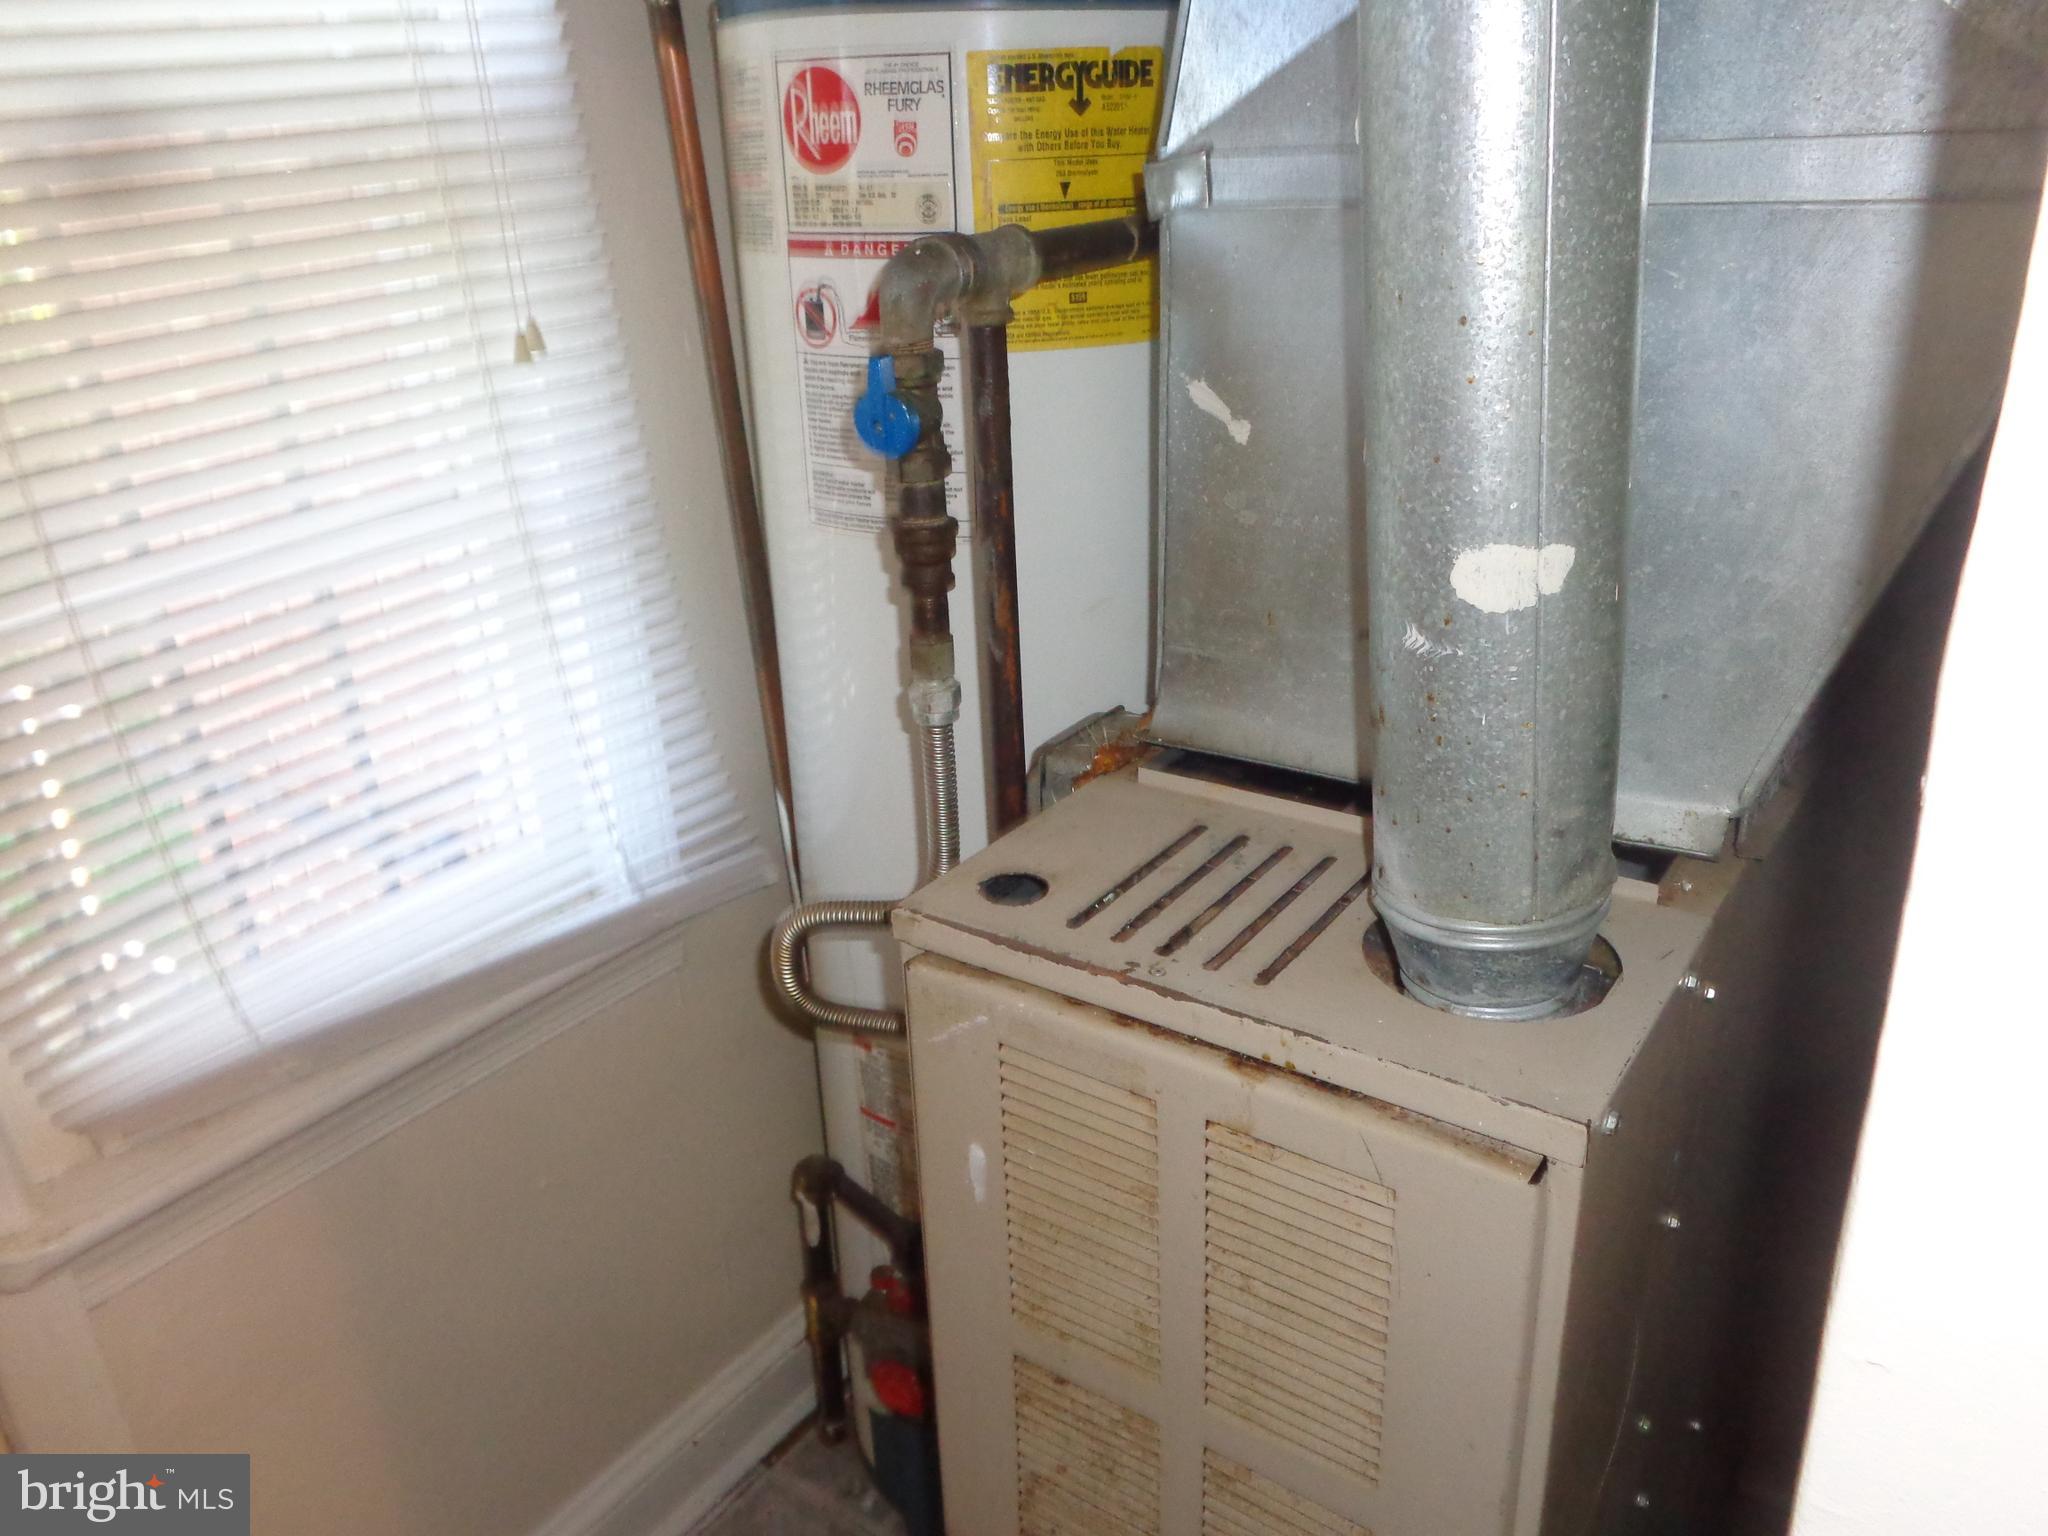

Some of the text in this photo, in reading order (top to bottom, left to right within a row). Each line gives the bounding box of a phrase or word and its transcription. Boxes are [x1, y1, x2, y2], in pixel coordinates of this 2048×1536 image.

[864, 79, 945, 97] RHEEMGLAS
[887, 98, 922, 112] FURY
[789, 66, 858, 161] Rheem
[1020, 130, 1034, 140] the
[1035, 128, 1062, 140] Energy
[1065, 128, 1078, 137] Use
[1081, 127, 1089, 136] of
[1091, 127, 1104, 136] this
[1106, 126, 1127, 137] Water
[1036, 140, 1062, 151] Others
[1064, 140, 1088, 150] Before
[1090, 139, 1105, 149] You
[840, 243, 908, 256] DANGE
